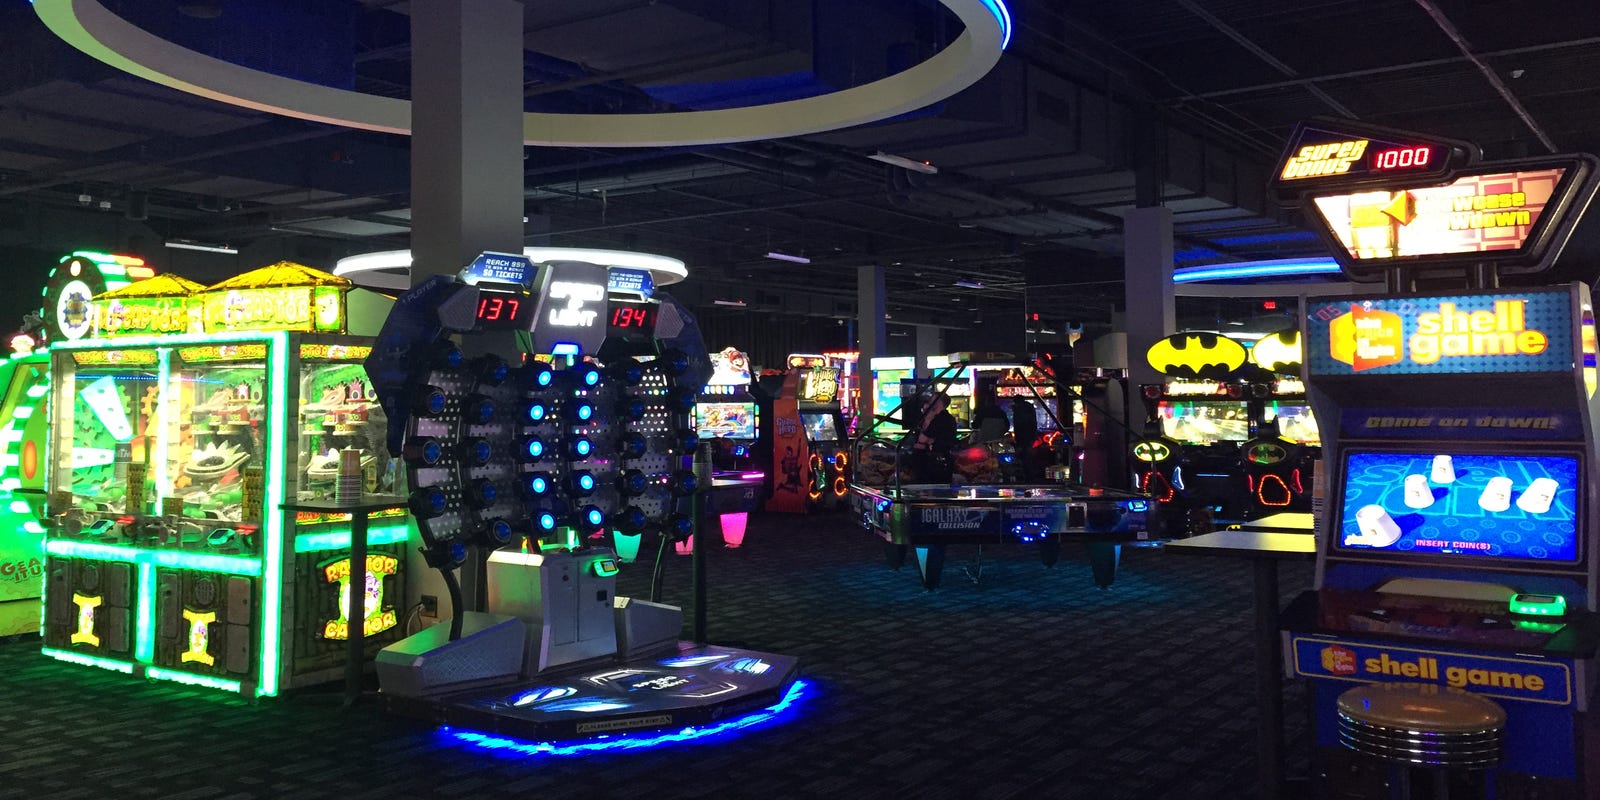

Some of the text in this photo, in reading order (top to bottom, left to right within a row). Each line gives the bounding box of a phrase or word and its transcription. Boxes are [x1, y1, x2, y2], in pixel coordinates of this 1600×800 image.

[1377, 147, 1429, 168] 1000
[485, 258, 510, 267] REACH
[495, 270, 524, 280] TICKETS
[476, 299, 520, 321] 137
[612, 306, 647, 328] 134
[1418, 299, 1524, 334] shell
[1409, 329, 1548, 365] game
[1365, 416, 1557, 429] come on down!
[925, 508, 969, 523] GALAXY
[1415, 539, 1491, 550] INSERT COIN(S)
[1, 557, 41, 576] GEA
[325, 555, 398, 583] RATOR
[324, 610, 398, 640] CATOR
[1365, 653, 1439, 680] shell
[1445, 666, 1545, 692] game
